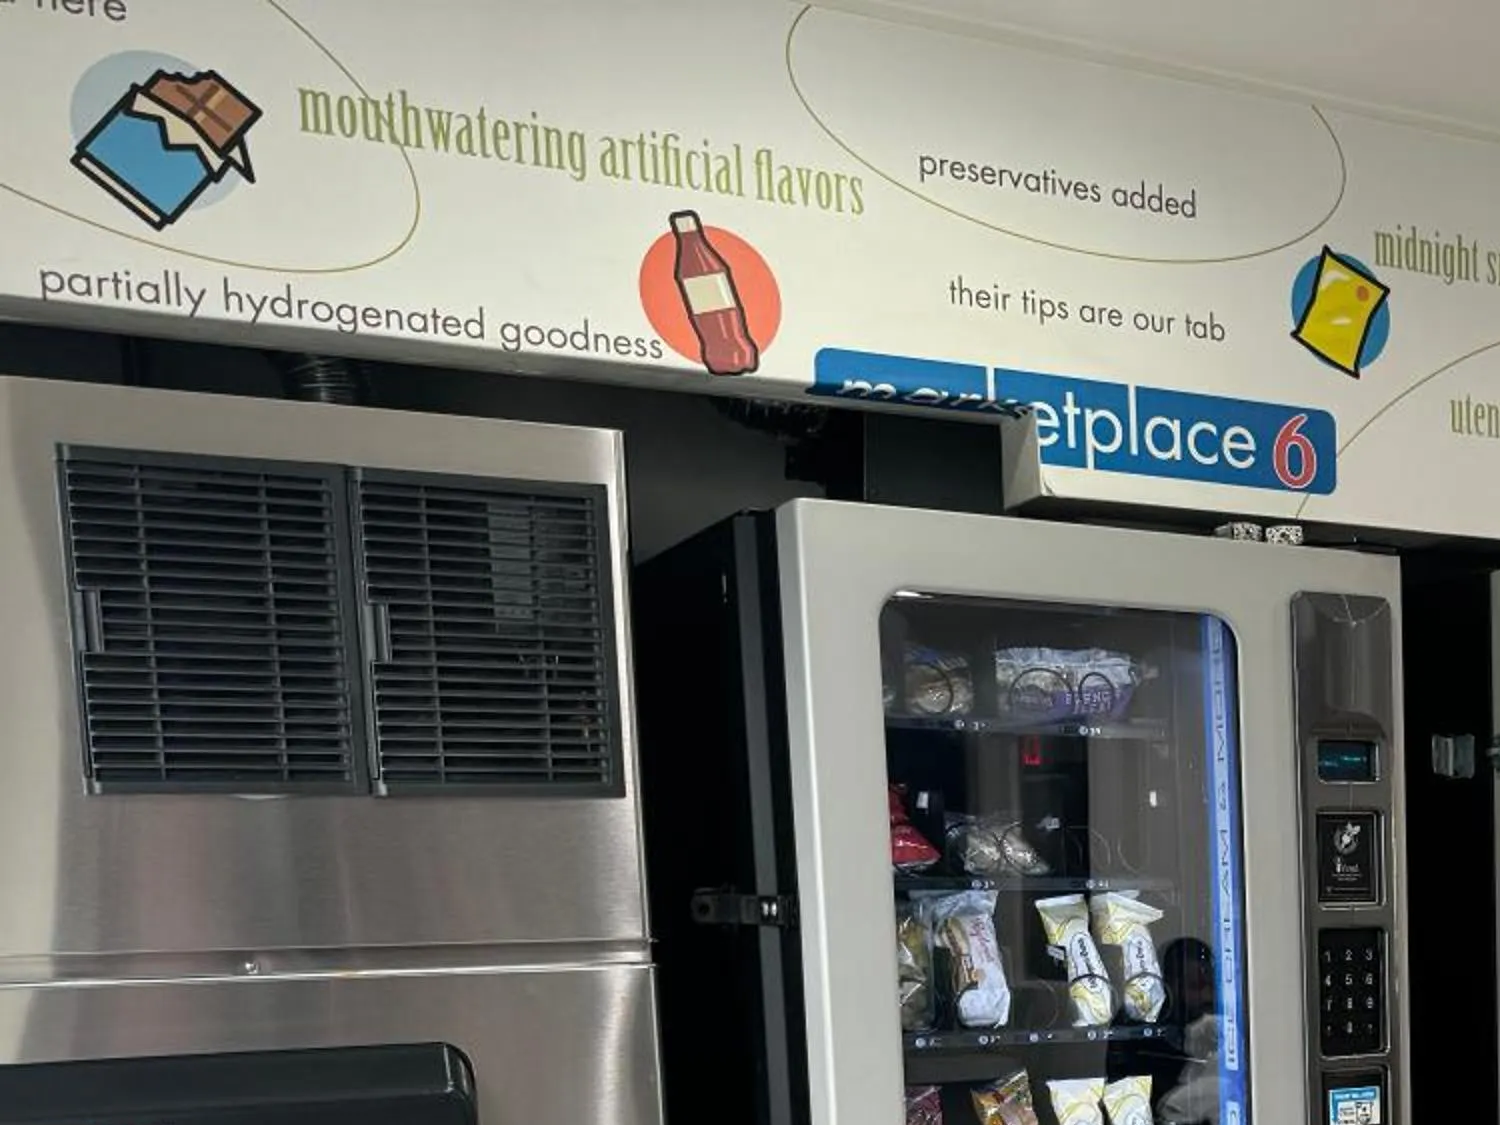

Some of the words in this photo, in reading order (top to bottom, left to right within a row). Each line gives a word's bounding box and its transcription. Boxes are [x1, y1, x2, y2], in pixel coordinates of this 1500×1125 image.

[299, 86, 586, 180] mouthwatering
[600, 133, 743, 198] artificial
[754, 150, 864, 215] flavors
[918, 154, 1101, 203] preservatives
[1113, 182, 1198, 219] added
[1374, 226, 1479, 285] midnight
[40, 264, 206, 317] partially
[223, 276, 486, 335] hydrogenated
[500, 317, 664, 360] goodness
[949, 277, 1011, 311] their
[1021, 288, 1069, 324] tips
[1080, 301, 1124, 328] are
[1132, 306, 1175, 335] our
[1185, 311, 1226, 342] tab
[1272, 413, 1317, 488] 6
[1218, 829, 1233, 984] CREAM
